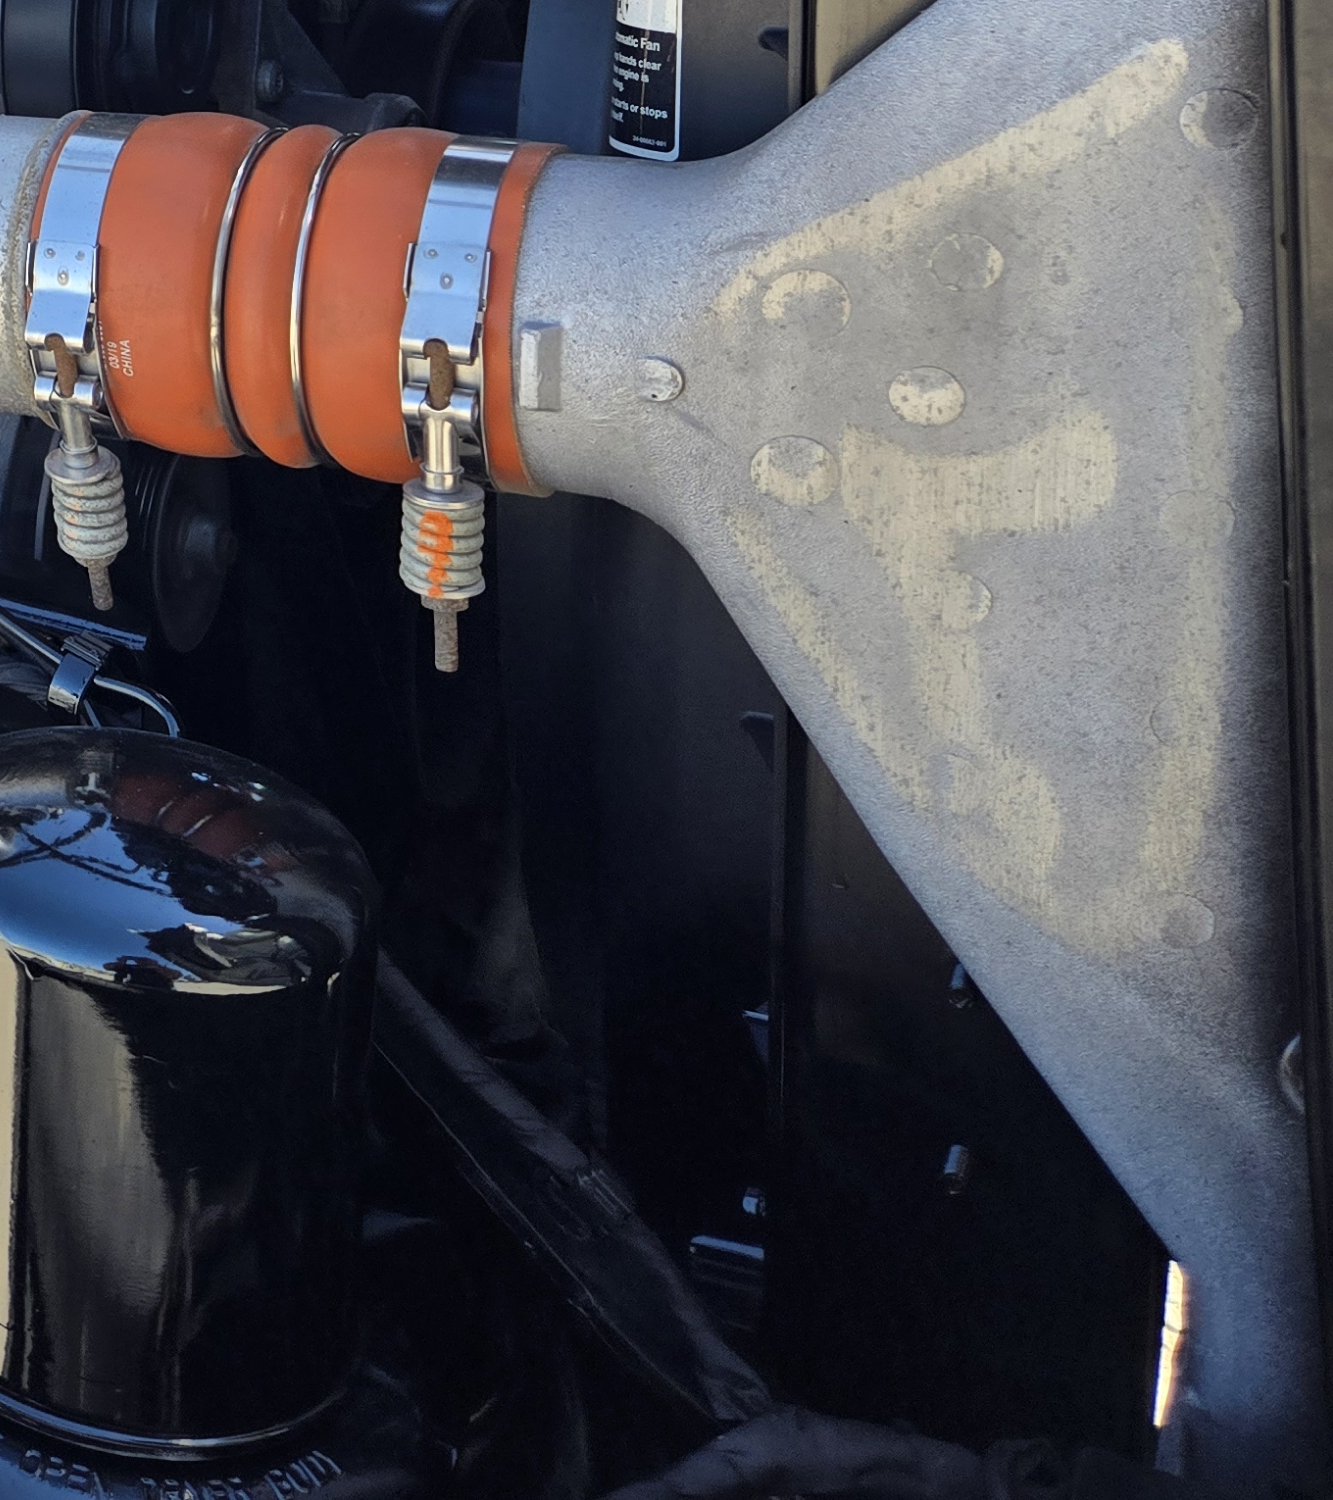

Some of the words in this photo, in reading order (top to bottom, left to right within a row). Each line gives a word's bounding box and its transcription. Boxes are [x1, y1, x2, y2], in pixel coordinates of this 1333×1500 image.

[640, 37, 660, 52] Fan
[638, 59, 662, 71] clear
[641, 72, 650, 83] is
[630, 105, 639, 113] or
[640, 106, 668, 120] stops
[107, 341, 119, 370] 03/19
[121, 339, 134, 378] CHINA
